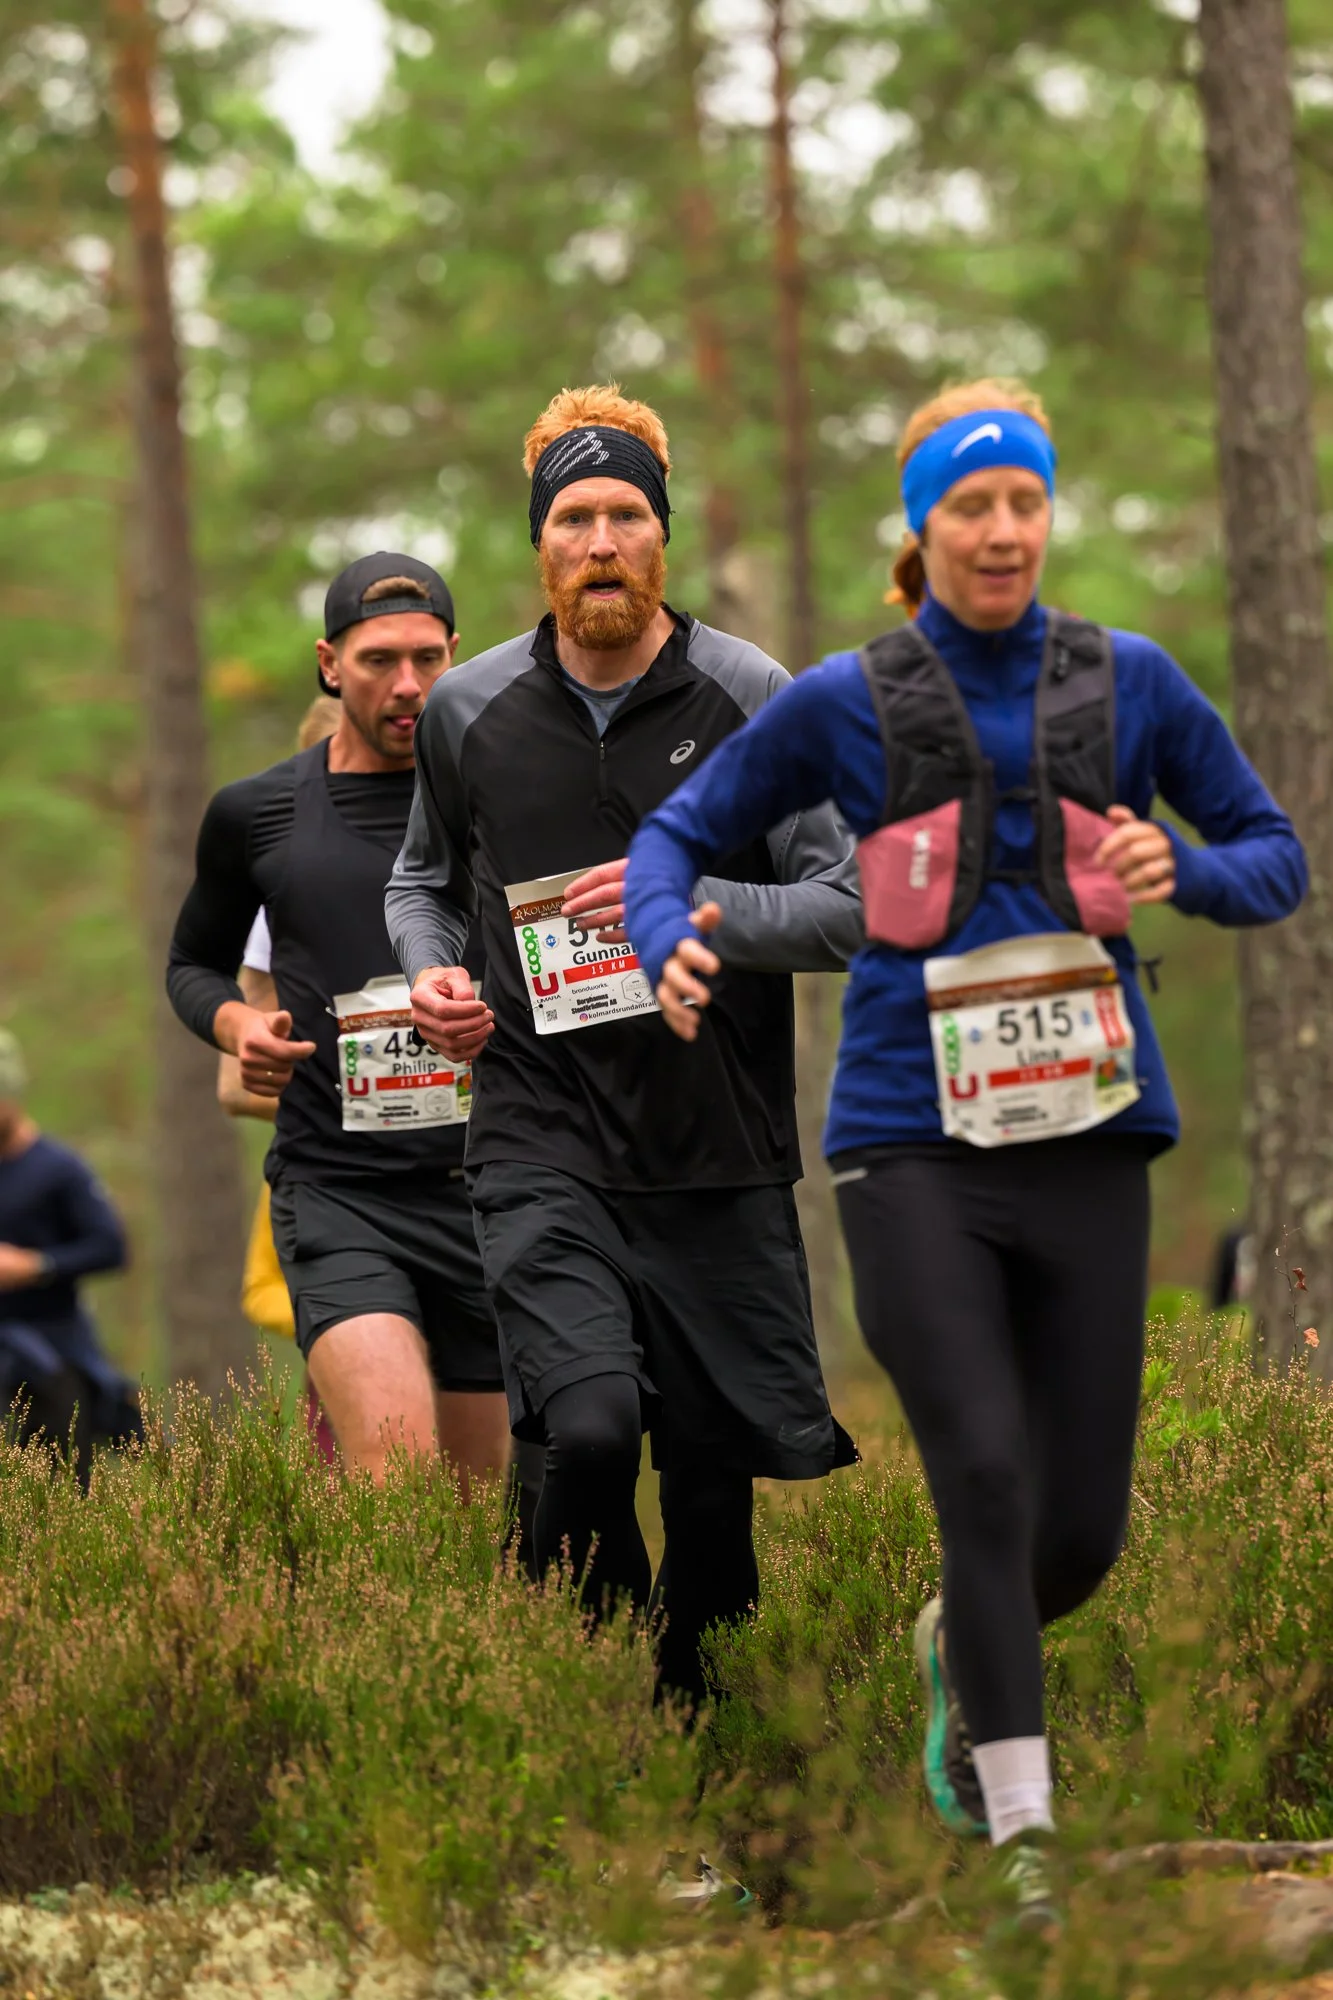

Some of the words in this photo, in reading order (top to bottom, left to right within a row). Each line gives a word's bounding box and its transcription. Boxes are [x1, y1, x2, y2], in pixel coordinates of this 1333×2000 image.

[522, 926, 541, 975] coop
[591, 965, 604, 975] 15
[611, 960, 626, 970] KM
[998, 1000, 1072, 1045] 515
[384, 1031, 440, 1059] 45
[392, 1059, 438, 1076] Philip
